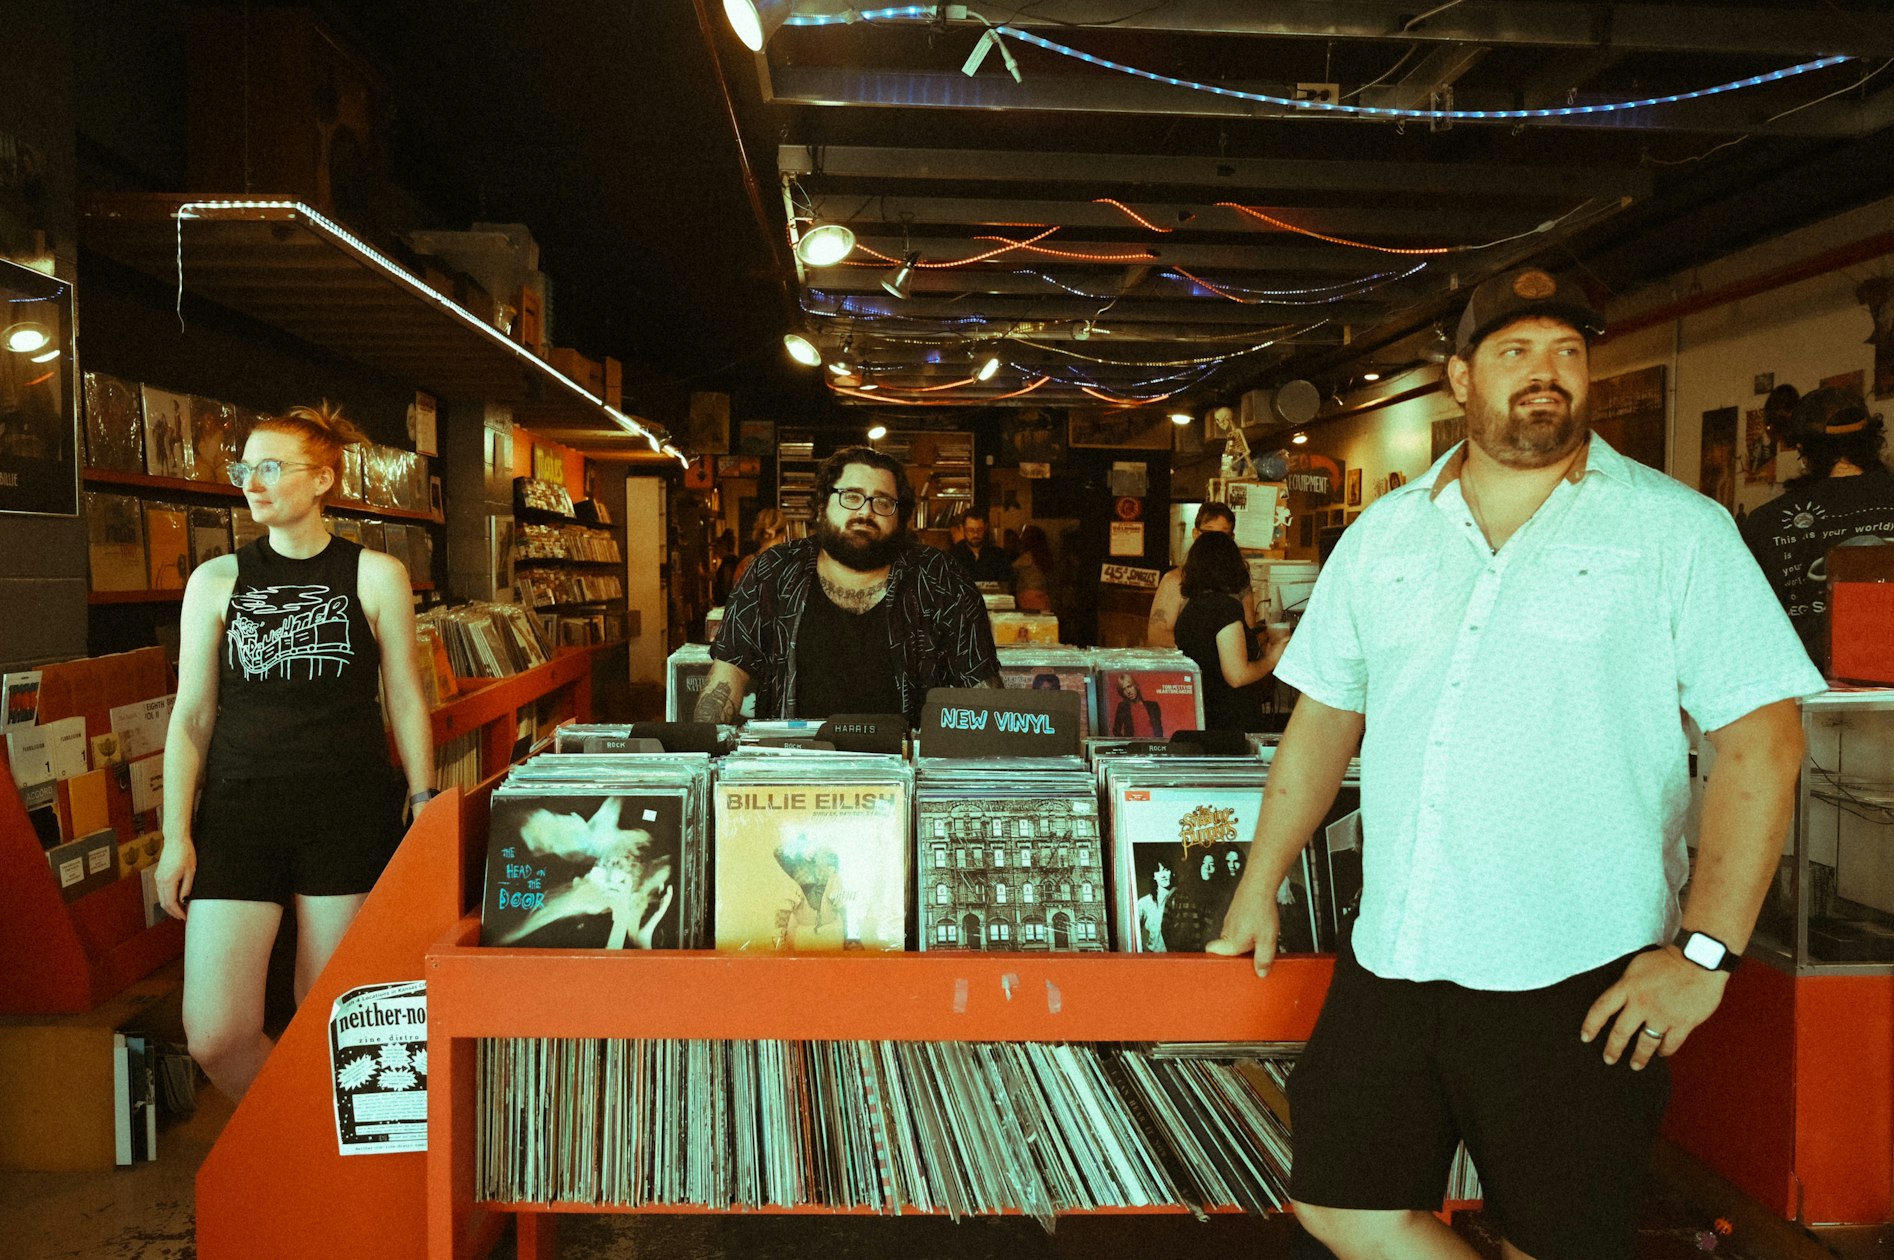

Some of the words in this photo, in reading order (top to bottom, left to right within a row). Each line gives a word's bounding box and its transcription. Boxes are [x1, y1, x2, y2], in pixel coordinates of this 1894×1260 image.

[1288, 473, 1329, 494] EQUIPMENT
[1772, 535, 1797, 547] This
[1822, 528, 1848, 539] your
[940, 707, 989, 730] NEW
[993, 711, 1056, 735] VINYL
[834, 724, 877, 734] HARRIS
[606, 741, 626, 749] ROCK
[45, 761, 51, 773] 1
[26, 786, 53, 801] ACCORD
[726, 793, 806, 810] BILLIE
[814, 793, 896, 811] EILISH
[501, 846, 515, 858] THE
[506, 863, 532, 879] HEAD
[527, 878, 542, 889] THE
[499, 888, 545, 910] DOOR
[397, 985, 418, 993] Kansas
[339, 1002, 426, 1033] neither-no
[358, 1036, 381, 1044] zine
[389, 1034, 419, 1042] distro
[1130, 1099, 1146, 1123] HEAR
